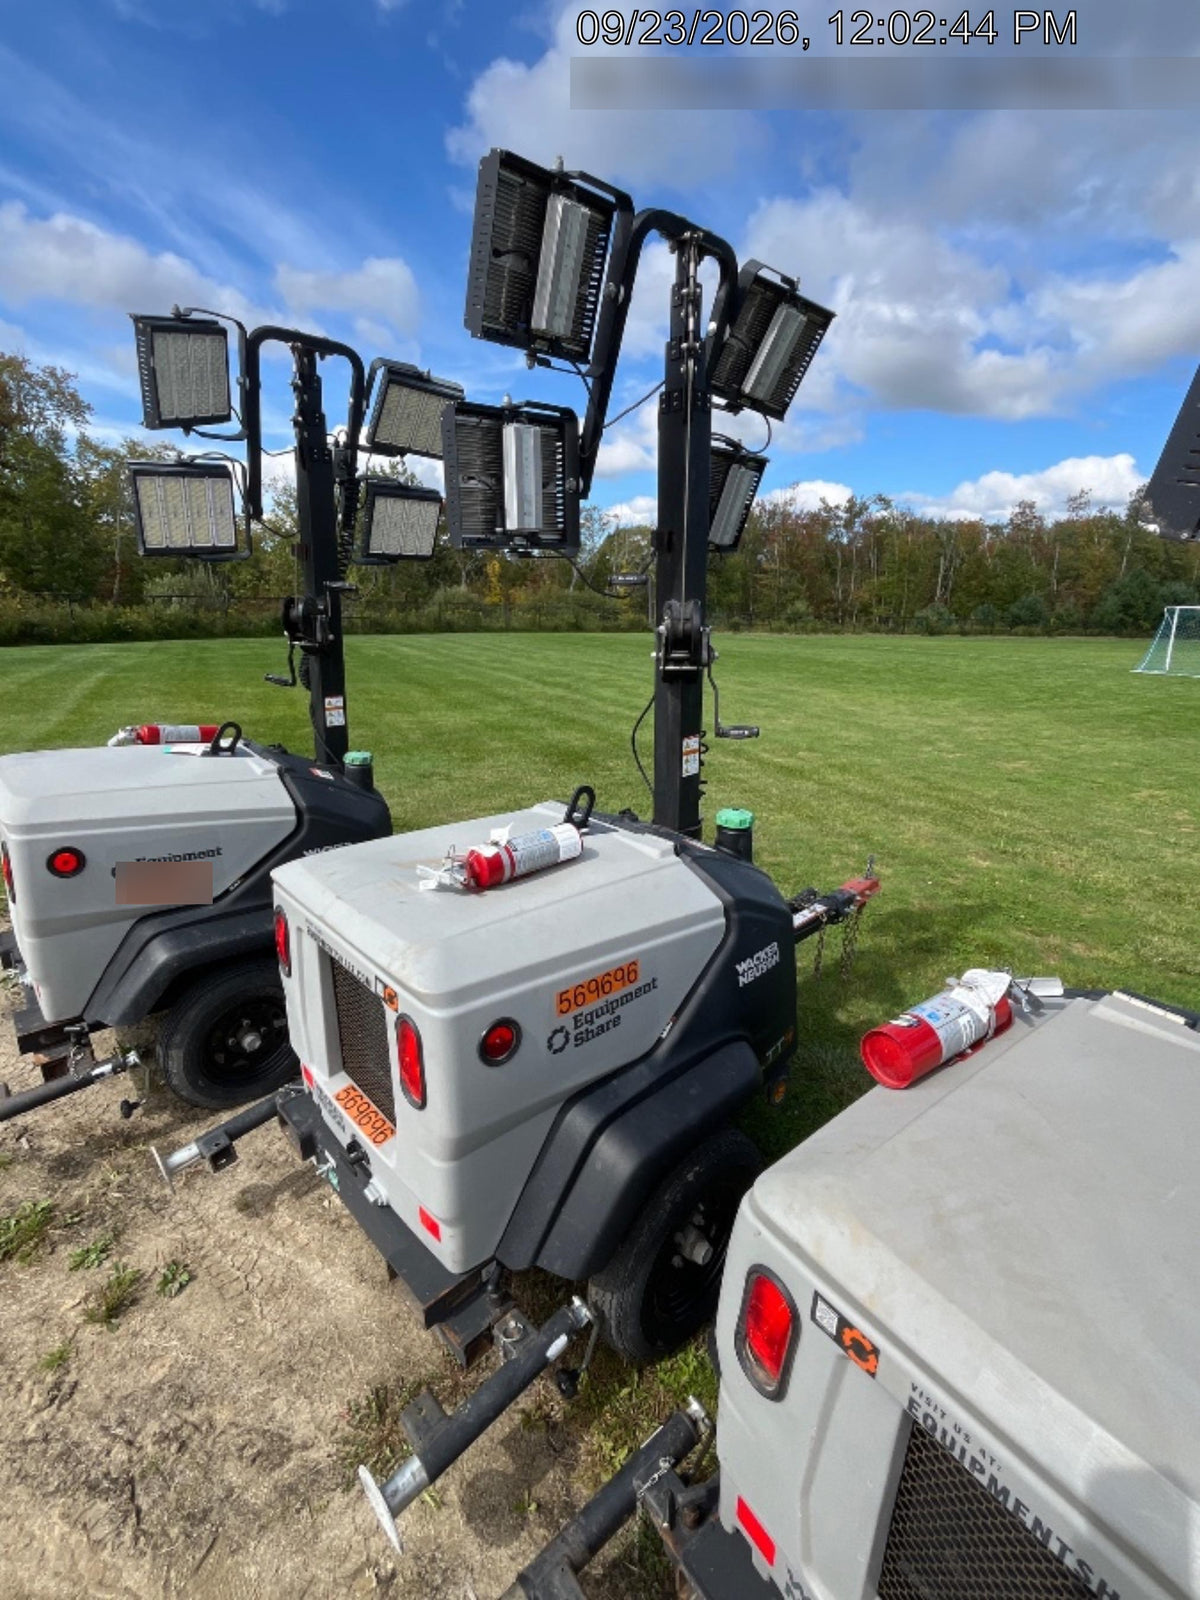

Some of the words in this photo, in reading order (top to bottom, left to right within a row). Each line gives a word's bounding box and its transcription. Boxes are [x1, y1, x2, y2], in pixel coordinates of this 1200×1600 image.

[558, 960, 639, 1015] 569696
[572, 976, 659, 1031] Equipment
[573, 1014, 622, 1048] Share
[335, 1084, 396, 1144] 569696
